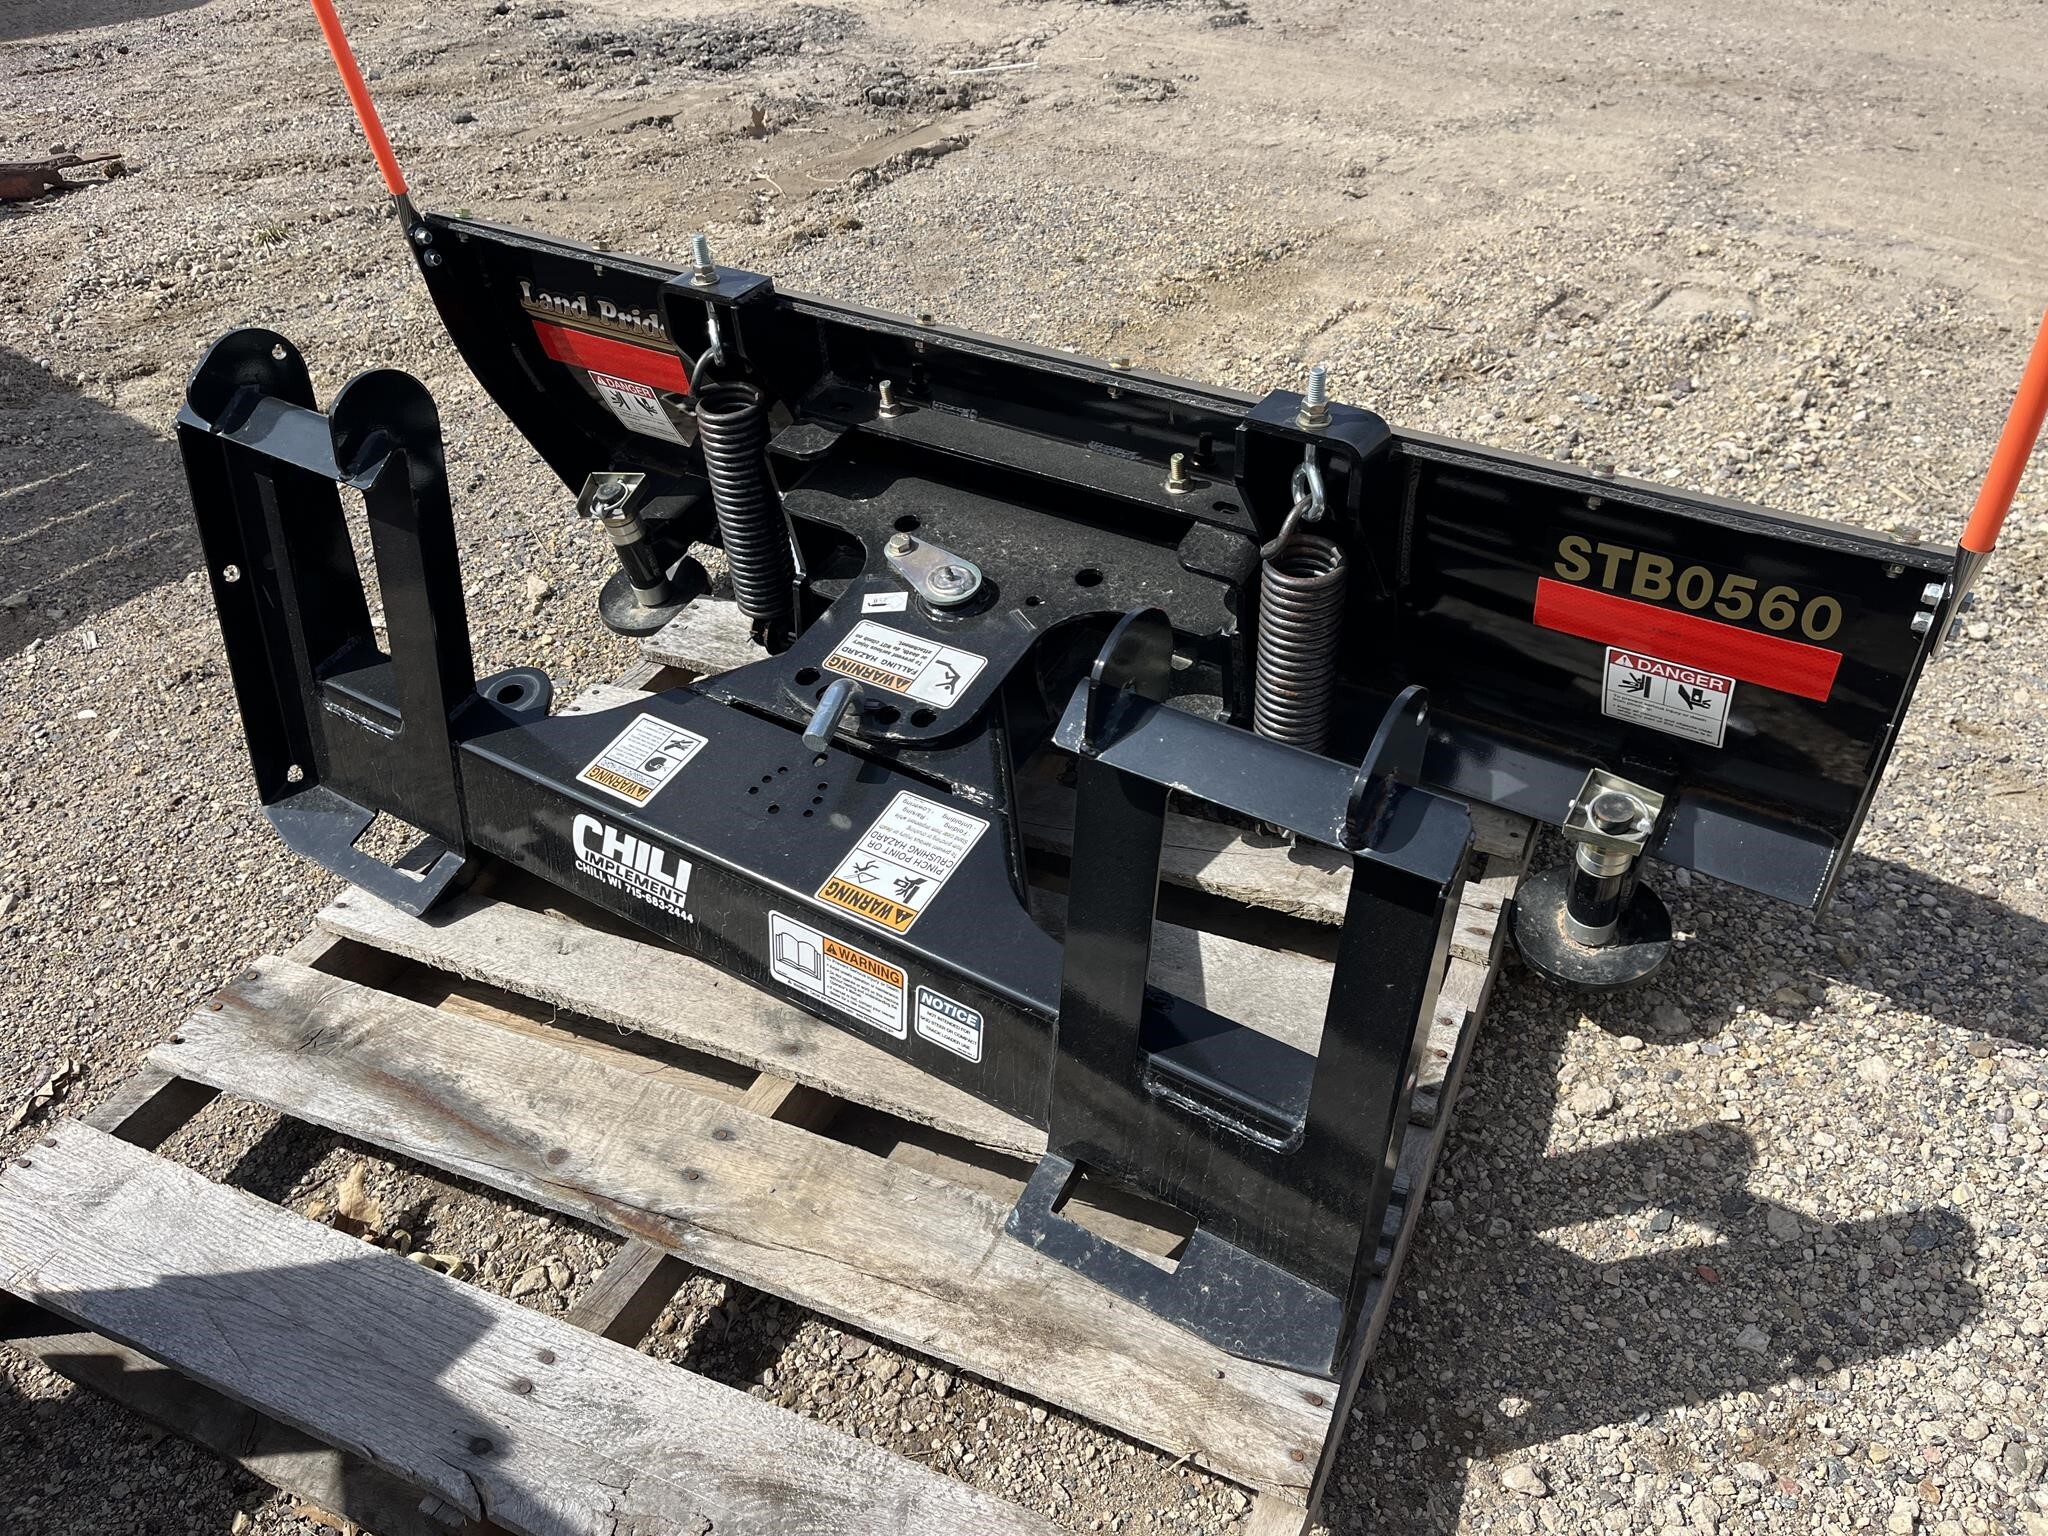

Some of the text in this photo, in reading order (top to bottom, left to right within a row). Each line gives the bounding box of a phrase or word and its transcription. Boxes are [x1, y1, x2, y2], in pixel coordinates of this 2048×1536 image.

[519, 281, 589, 321] Land
[606, 378, 651, 397] DANGER
[1554, 535, 1843, 641] STB0560
[829, 657, 894, 685] WARNING
[842, 647, 918, 675] FALLING HAZARD
[1638, 660, 1723, 690] DANGER
[590, 768, 637, 794] WARNING
[573, 813, 692, 893] CHILI
[867, 840, 944, 875] PINCH POINT OR
[871, 831, 953, 868] CRUSHING HAZARD
[575, 860, 694, 924] CHILI, WI 715-683-2444
[584, 850, 683, 905] IMPLEMENT
[826, 882, 893, 919] WARNING
[839, 948, 899, 983] WARNING
[922, 993, 977, 1026] NOTICE
